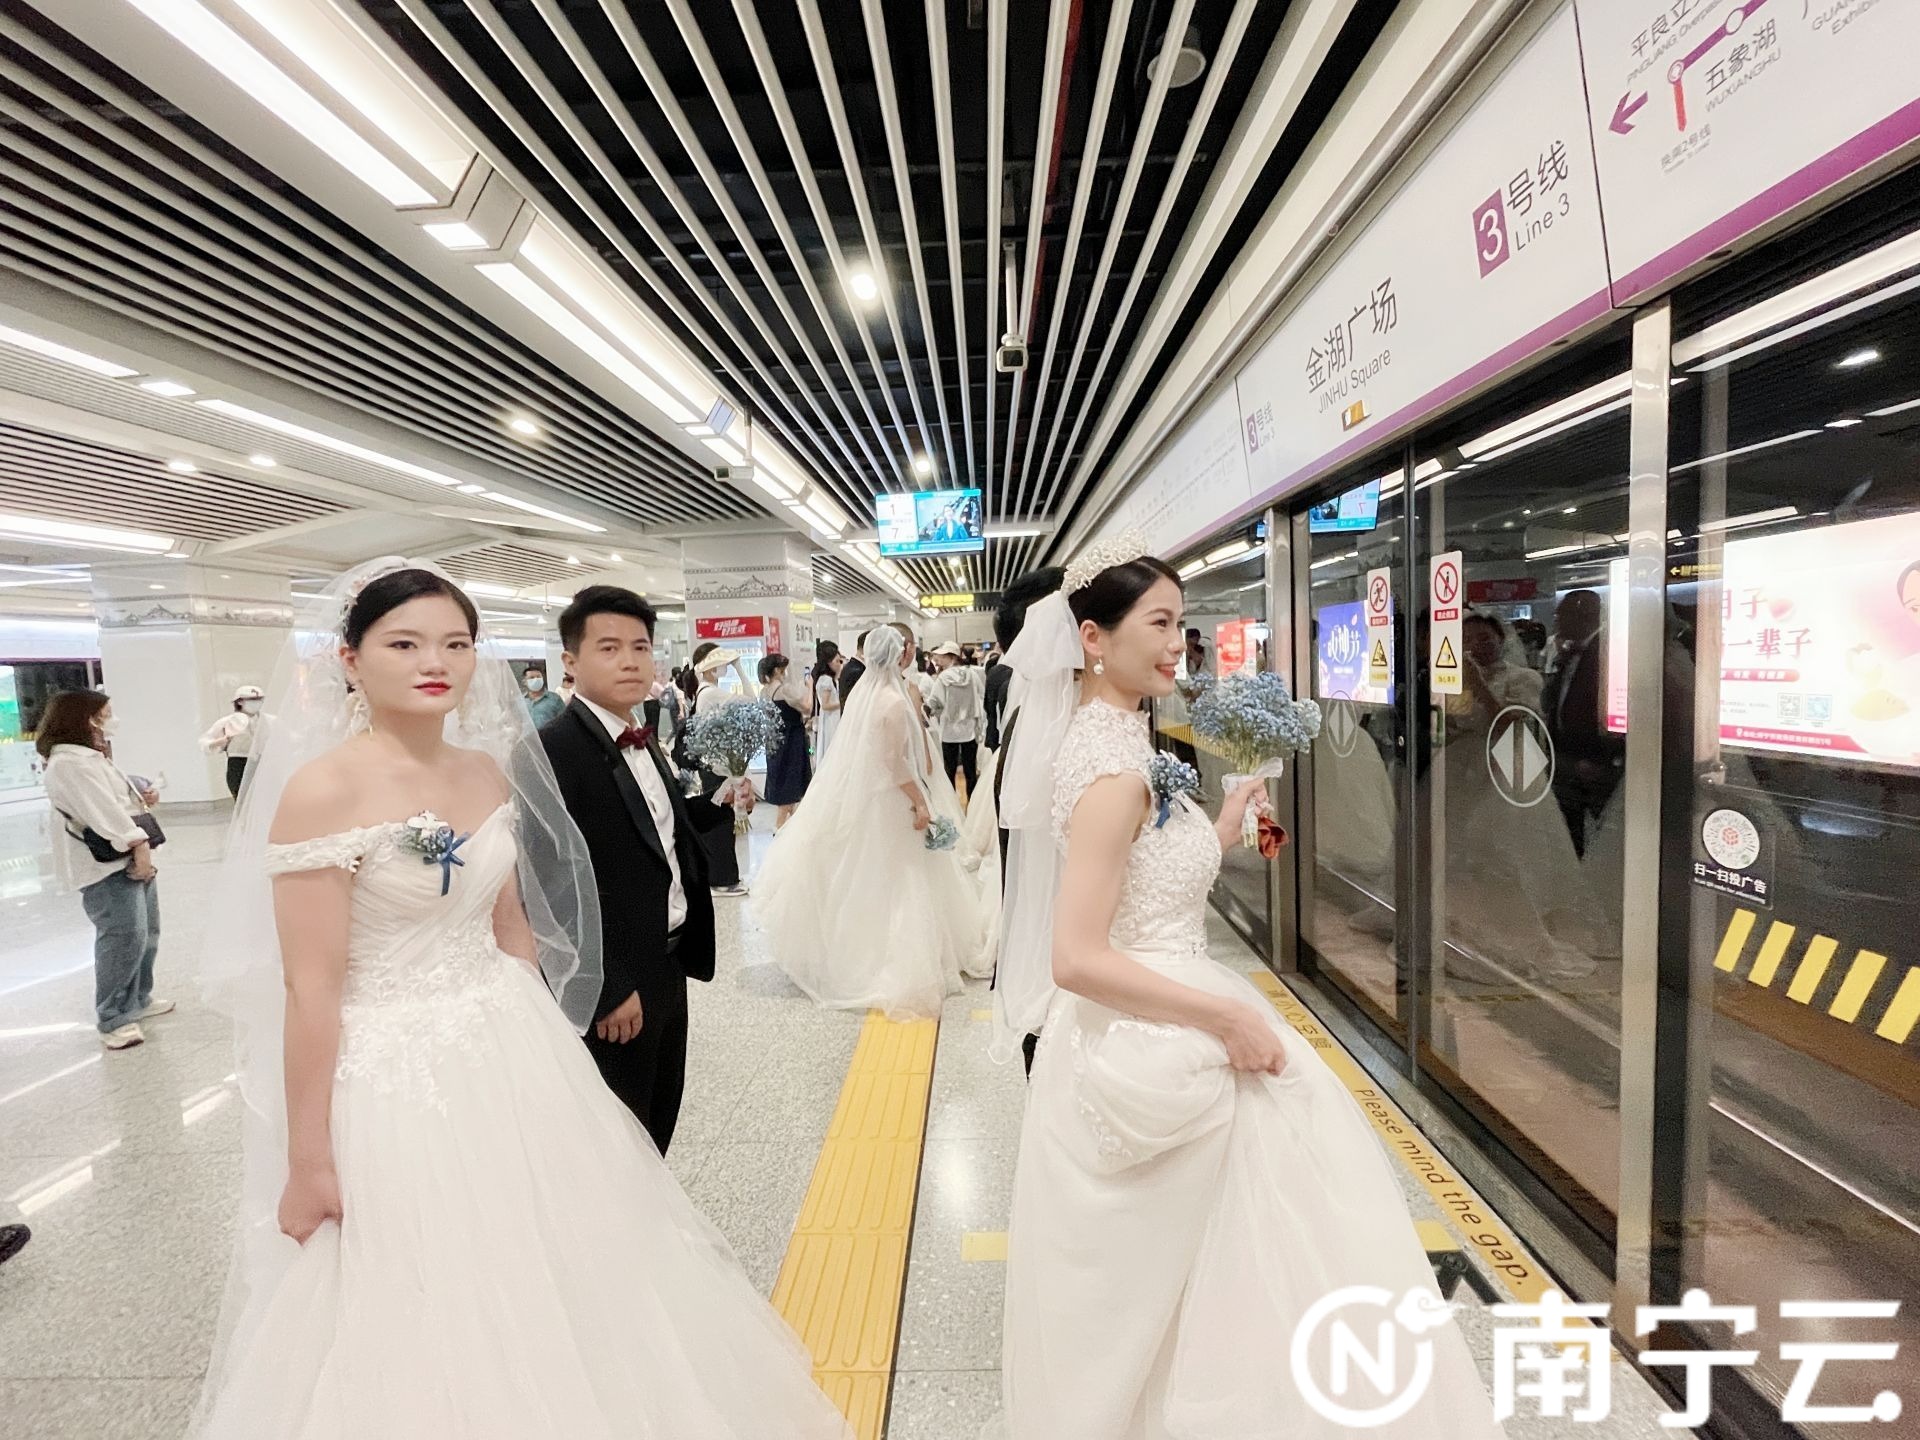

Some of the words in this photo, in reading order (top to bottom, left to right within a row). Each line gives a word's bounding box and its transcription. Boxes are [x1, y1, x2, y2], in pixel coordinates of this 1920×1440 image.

[1704, 18, 1778, 96] 五象湖
[1705, 47, 1782, 113] WUXIANGHU
[1479, 207, 1503, 262] 3
[1506, 139, 1569, 217] 号线
[1515, 211, 1554, 251] Line
[1558, 192, 1570, 217] 3
[1305, 276, 1398, 394] 金湖广场
[1318, 376, 1349, 414] JINHU
[1350, 350, 1391, 389] Square
[1247, 420, 1258, 448] 3
[1720, 628, 1812, 661] 一辈子
[1693, 861, 1767, 895] 扫一扫投广告
[1355, 1088, 1404, 1136] Please
[1397, 1138, 1452, 1184] mind
[1442, 1190, 1482, 1226] the
[1470, 1232, 1530, 1287] gap.
